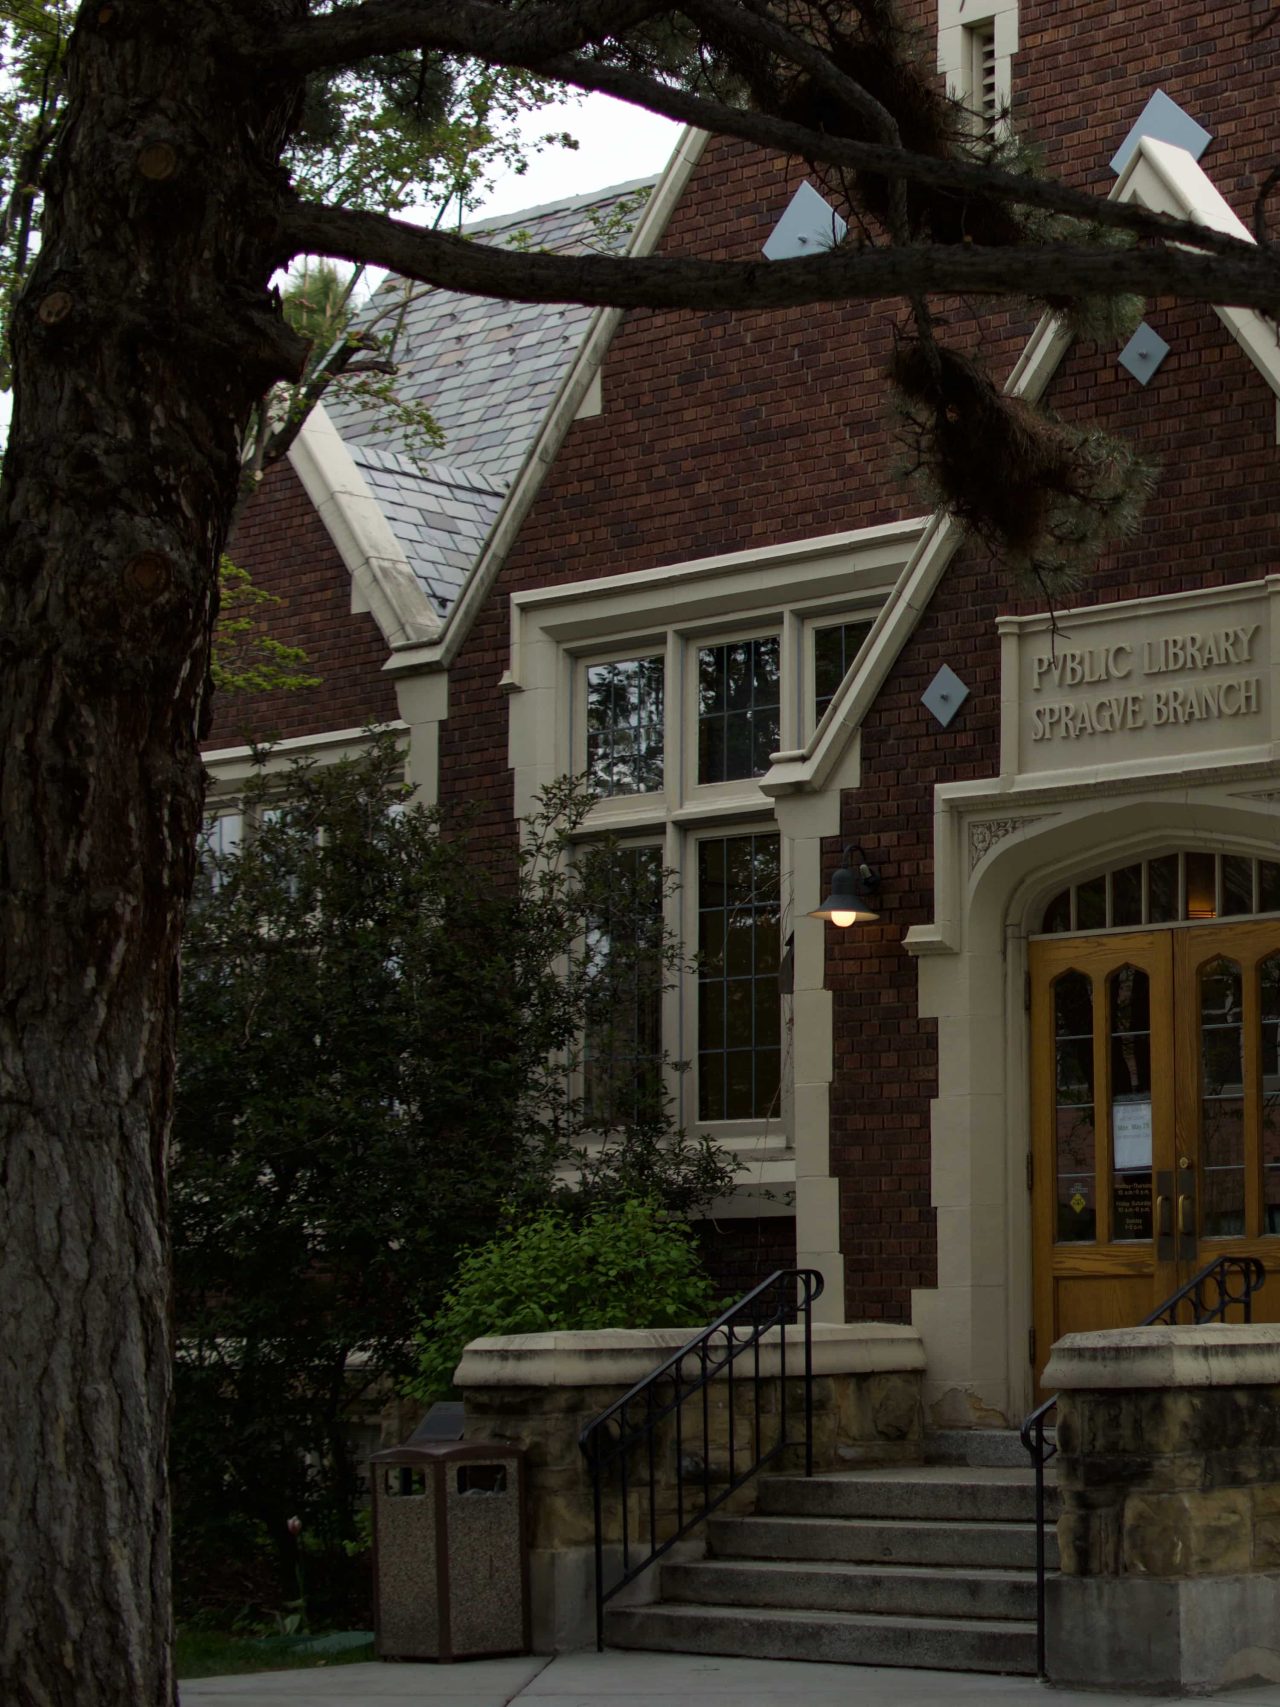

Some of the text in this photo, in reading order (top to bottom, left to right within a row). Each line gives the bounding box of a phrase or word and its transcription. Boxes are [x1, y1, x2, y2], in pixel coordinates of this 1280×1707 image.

[1143, 624, 1261, 675] LIBRARY
[1031, 678, 1261, 741] SPRAGVE BRANCH
